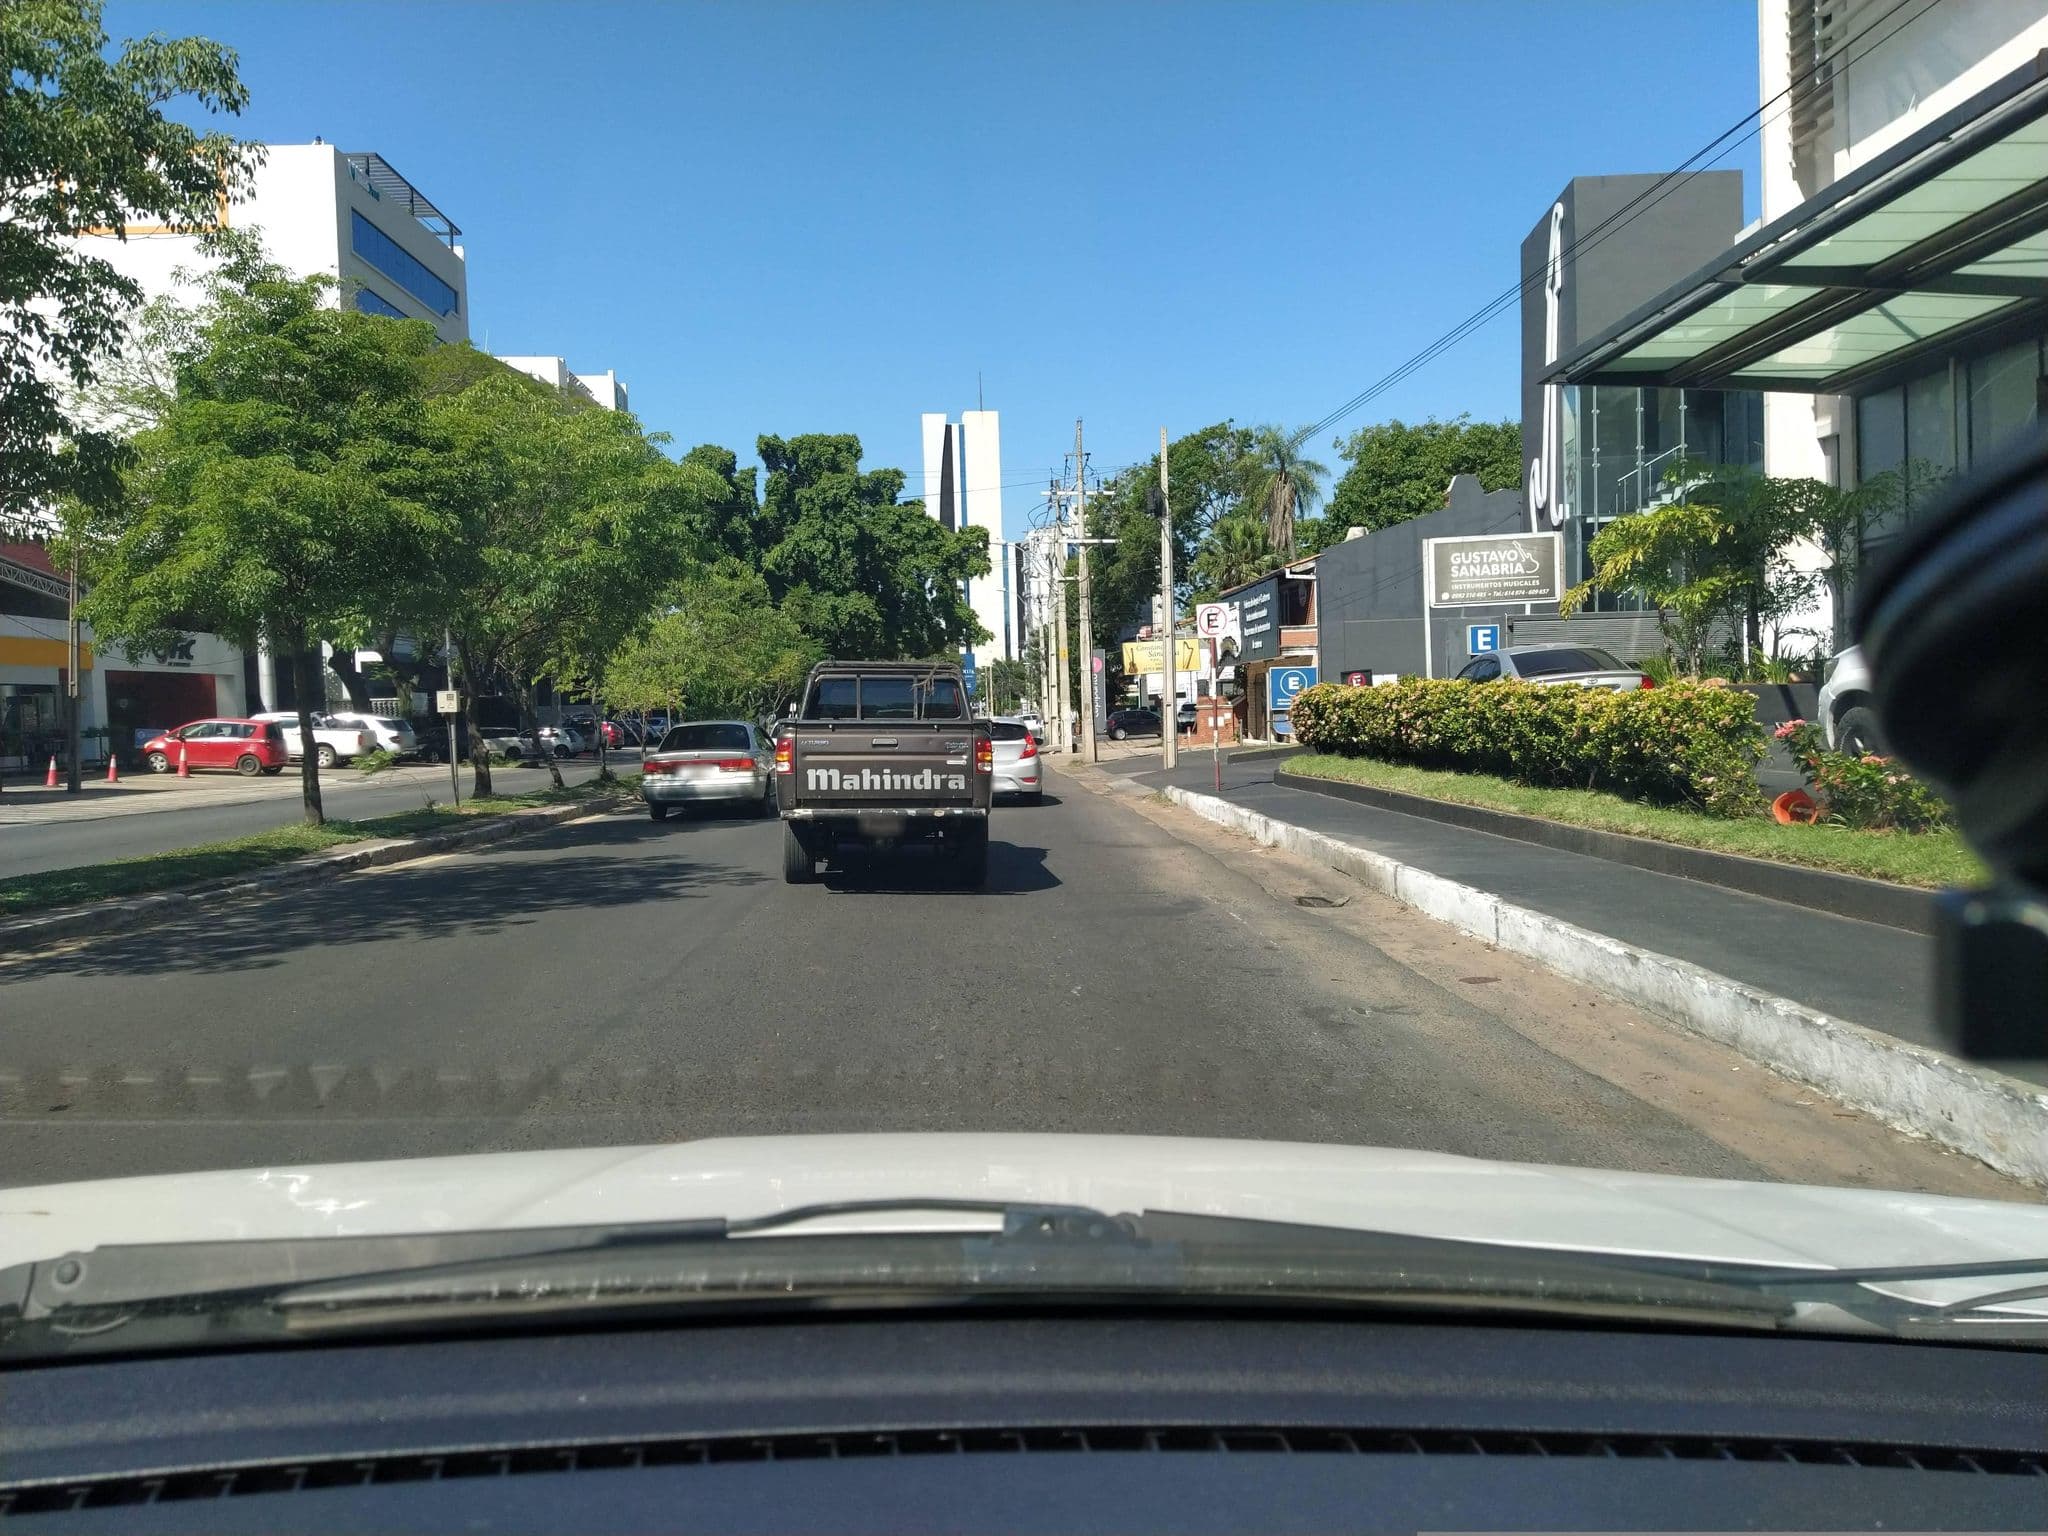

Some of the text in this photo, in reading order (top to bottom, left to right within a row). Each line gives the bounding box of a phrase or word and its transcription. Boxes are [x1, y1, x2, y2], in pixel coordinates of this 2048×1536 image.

[1450, 549, 1518, 564] GUSTAVO
[1450, 562, 1525, 578] SANABRIA
[1451, 579, 1540, 590] INSTRUMENTOS MUSICALES
[1207, 613, 1219, 628] E
[1477, 629, 1491, 650] E
[1288, 677, 1300, 689] E
[806, 768, 966, 791] Mahindra
